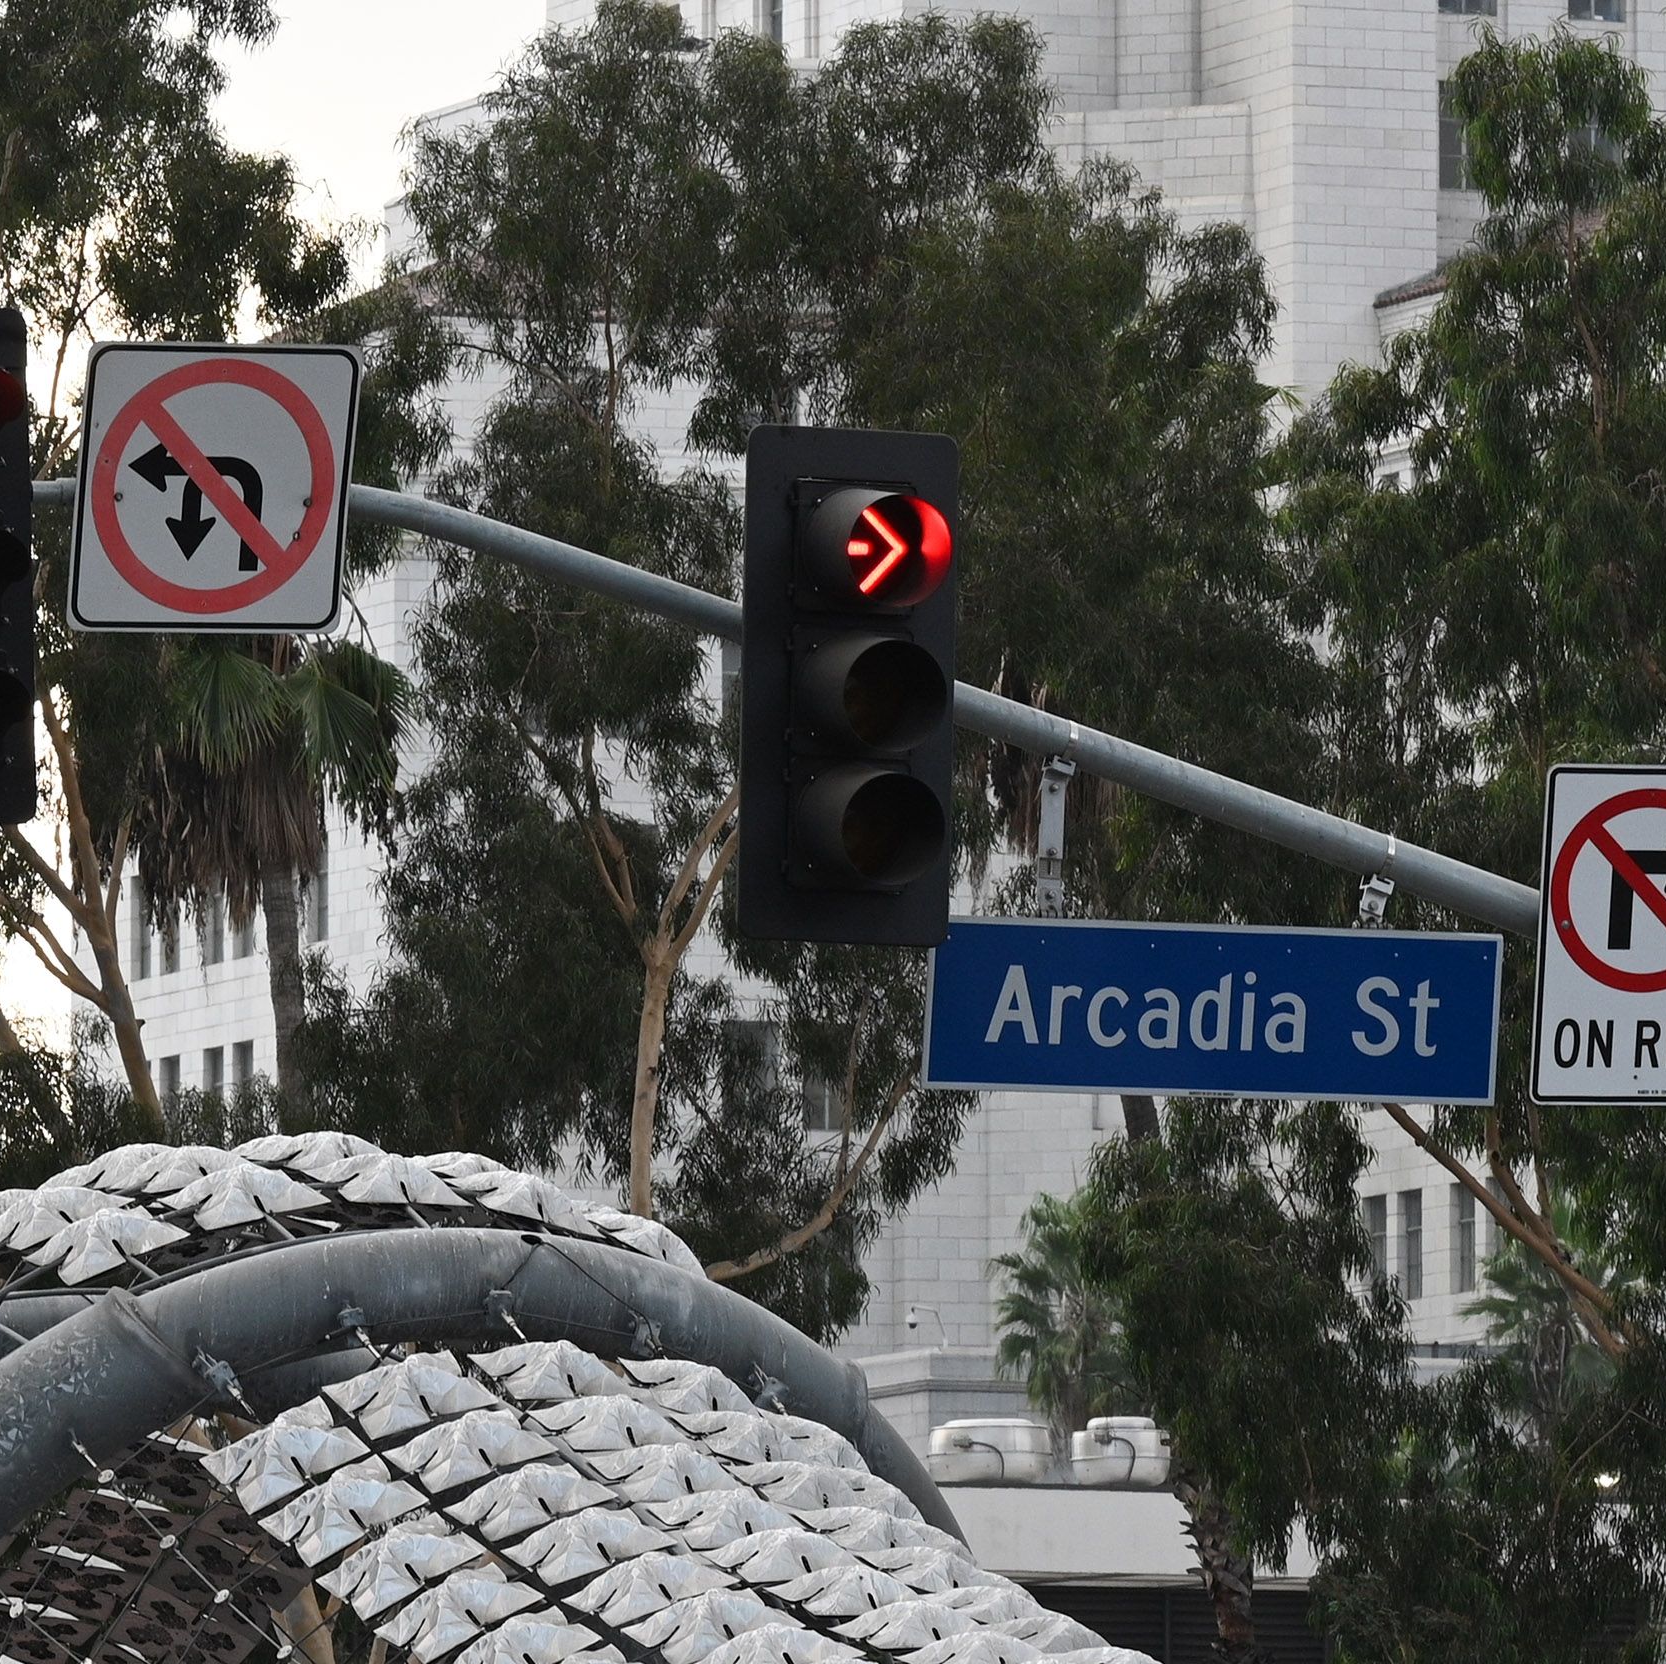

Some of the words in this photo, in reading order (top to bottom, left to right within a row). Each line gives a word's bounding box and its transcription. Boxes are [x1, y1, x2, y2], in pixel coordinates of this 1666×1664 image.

[984, 964, 1307, 1054] Arcadia
[1351, 975, 1440, 1058] St
[1554, 1018, 1614, 1069] ON
